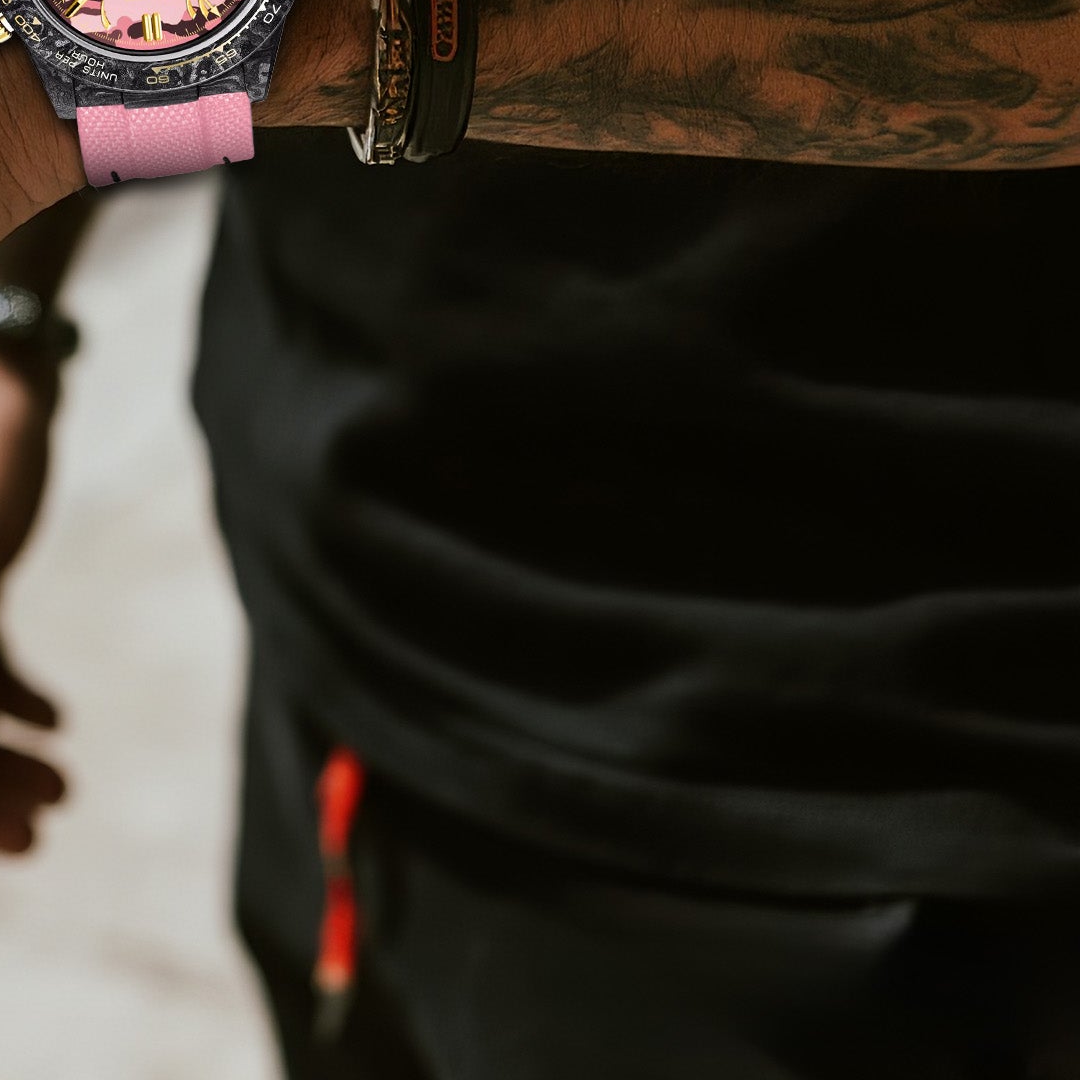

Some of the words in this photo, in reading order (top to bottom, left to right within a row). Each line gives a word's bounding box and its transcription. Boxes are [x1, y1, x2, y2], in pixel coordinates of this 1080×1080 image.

[263, 4, 282, 24] 70
[14, 15, 41, 42] 400
[54, 51, 79, 68] PER
[71, 50, 106, 69] HOUR
[215, 48, 237, 65] 65
[82, 65, 118, 82] UNITS
[146, 76, 170, 84] 60
